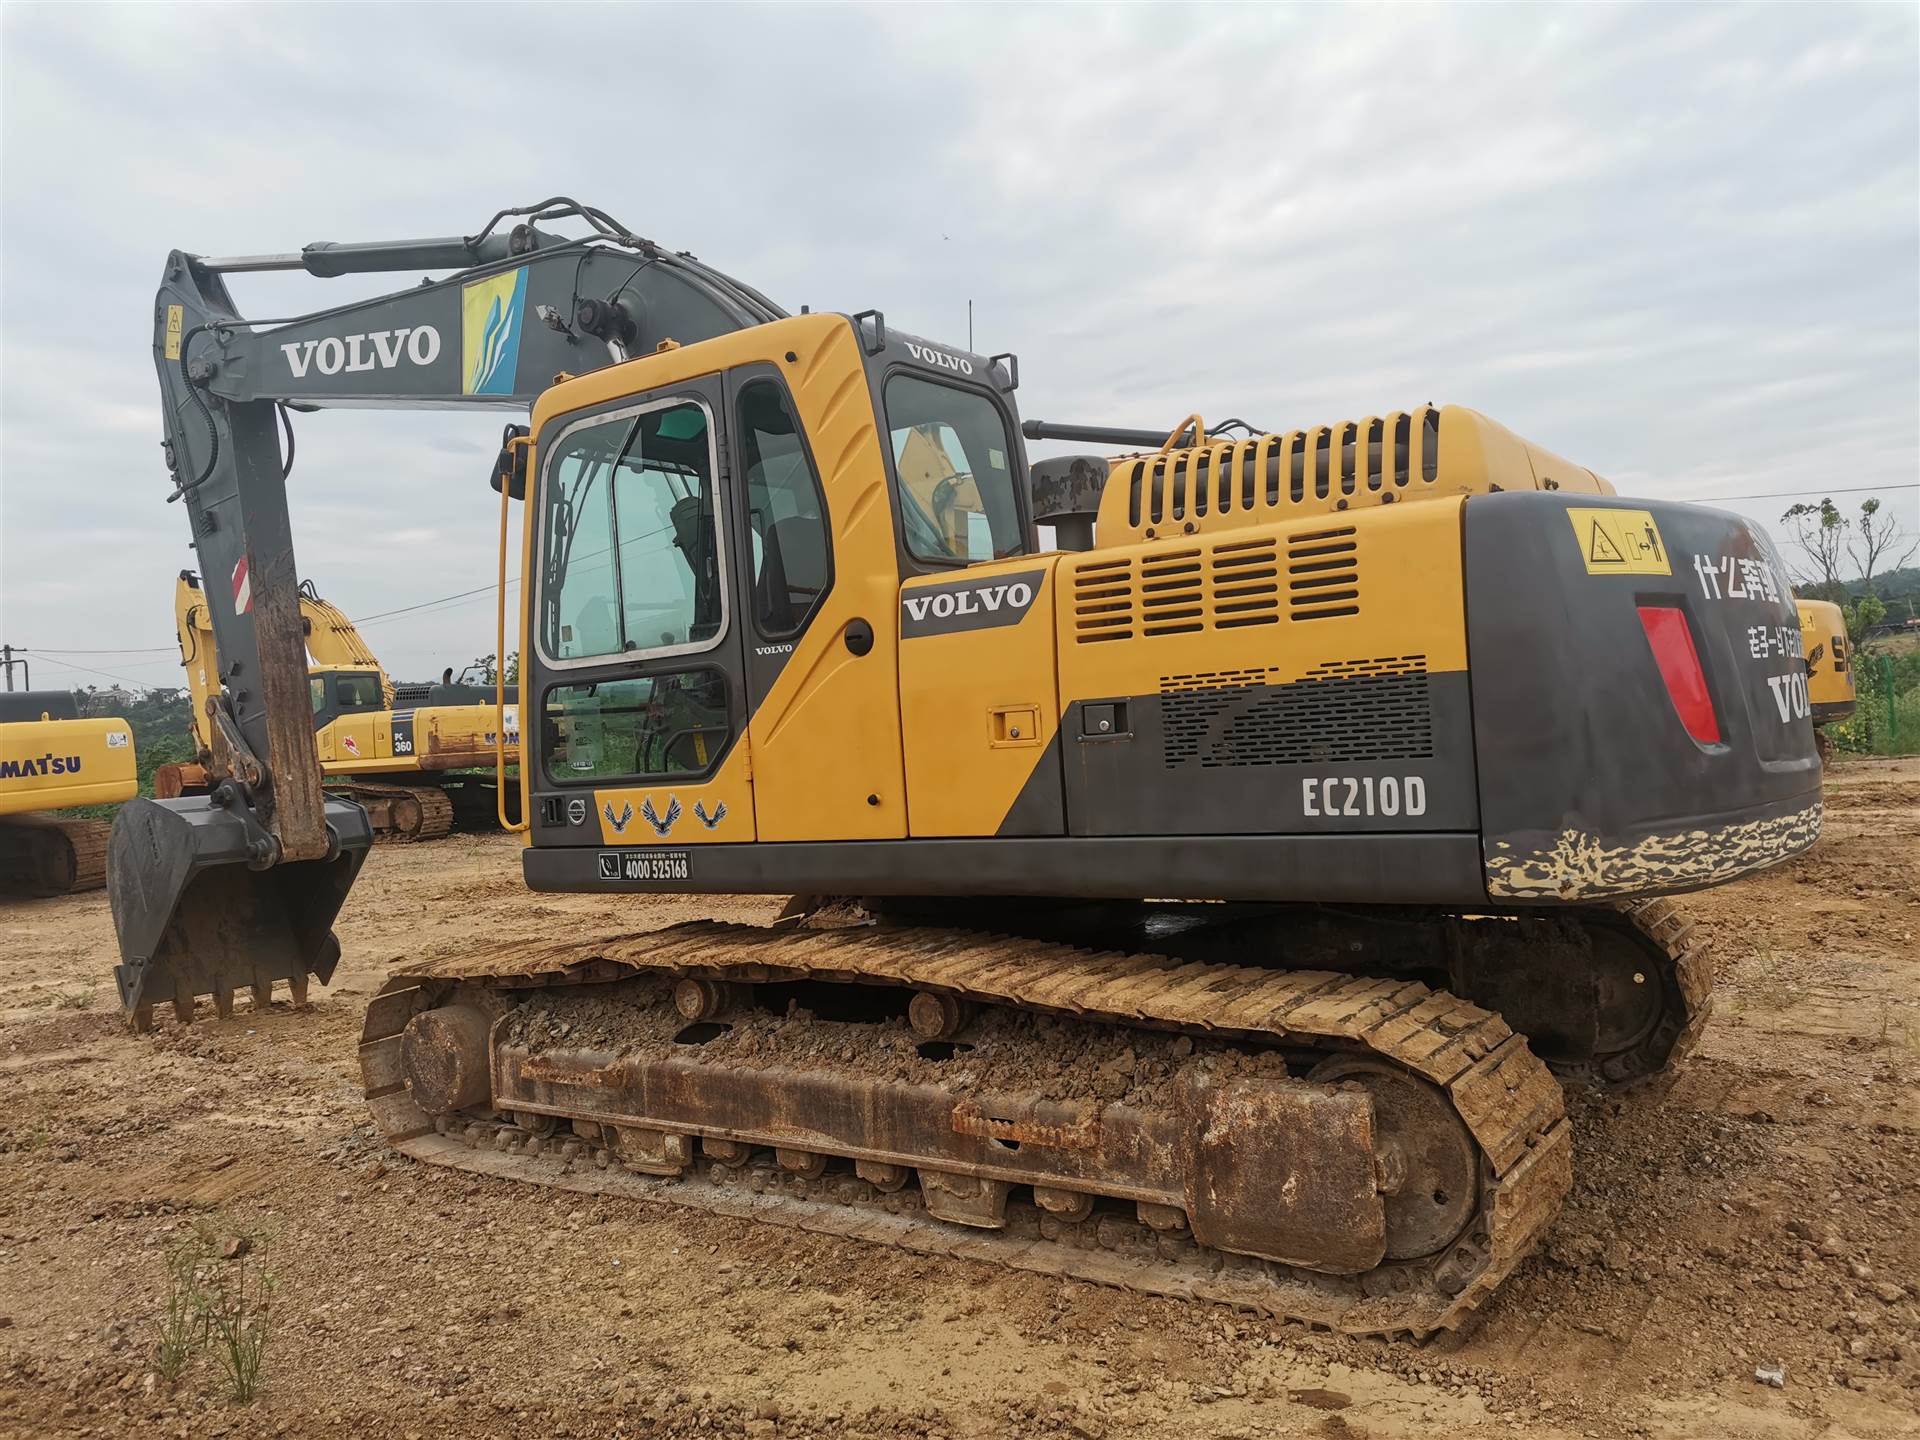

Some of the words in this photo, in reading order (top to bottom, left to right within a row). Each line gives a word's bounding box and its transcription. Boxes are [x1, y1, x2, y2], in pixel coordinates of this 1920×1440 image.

[281, 325, 441, 378] VOLVO
[904, 342, 973, 375] VOLVO
[903, 582, 1032, 621] VOLVO
[755, 644, 793, 655] VOLVO
[394, 733, 403, 741] PC
[395, 741, 412, 752] 360
[0, 753, 81, 778] MATSU
[1302, 776, 1426, 816] EC210D
[626, 860, 650, 879] 4000
[652, 859, 688, 879] 525168
